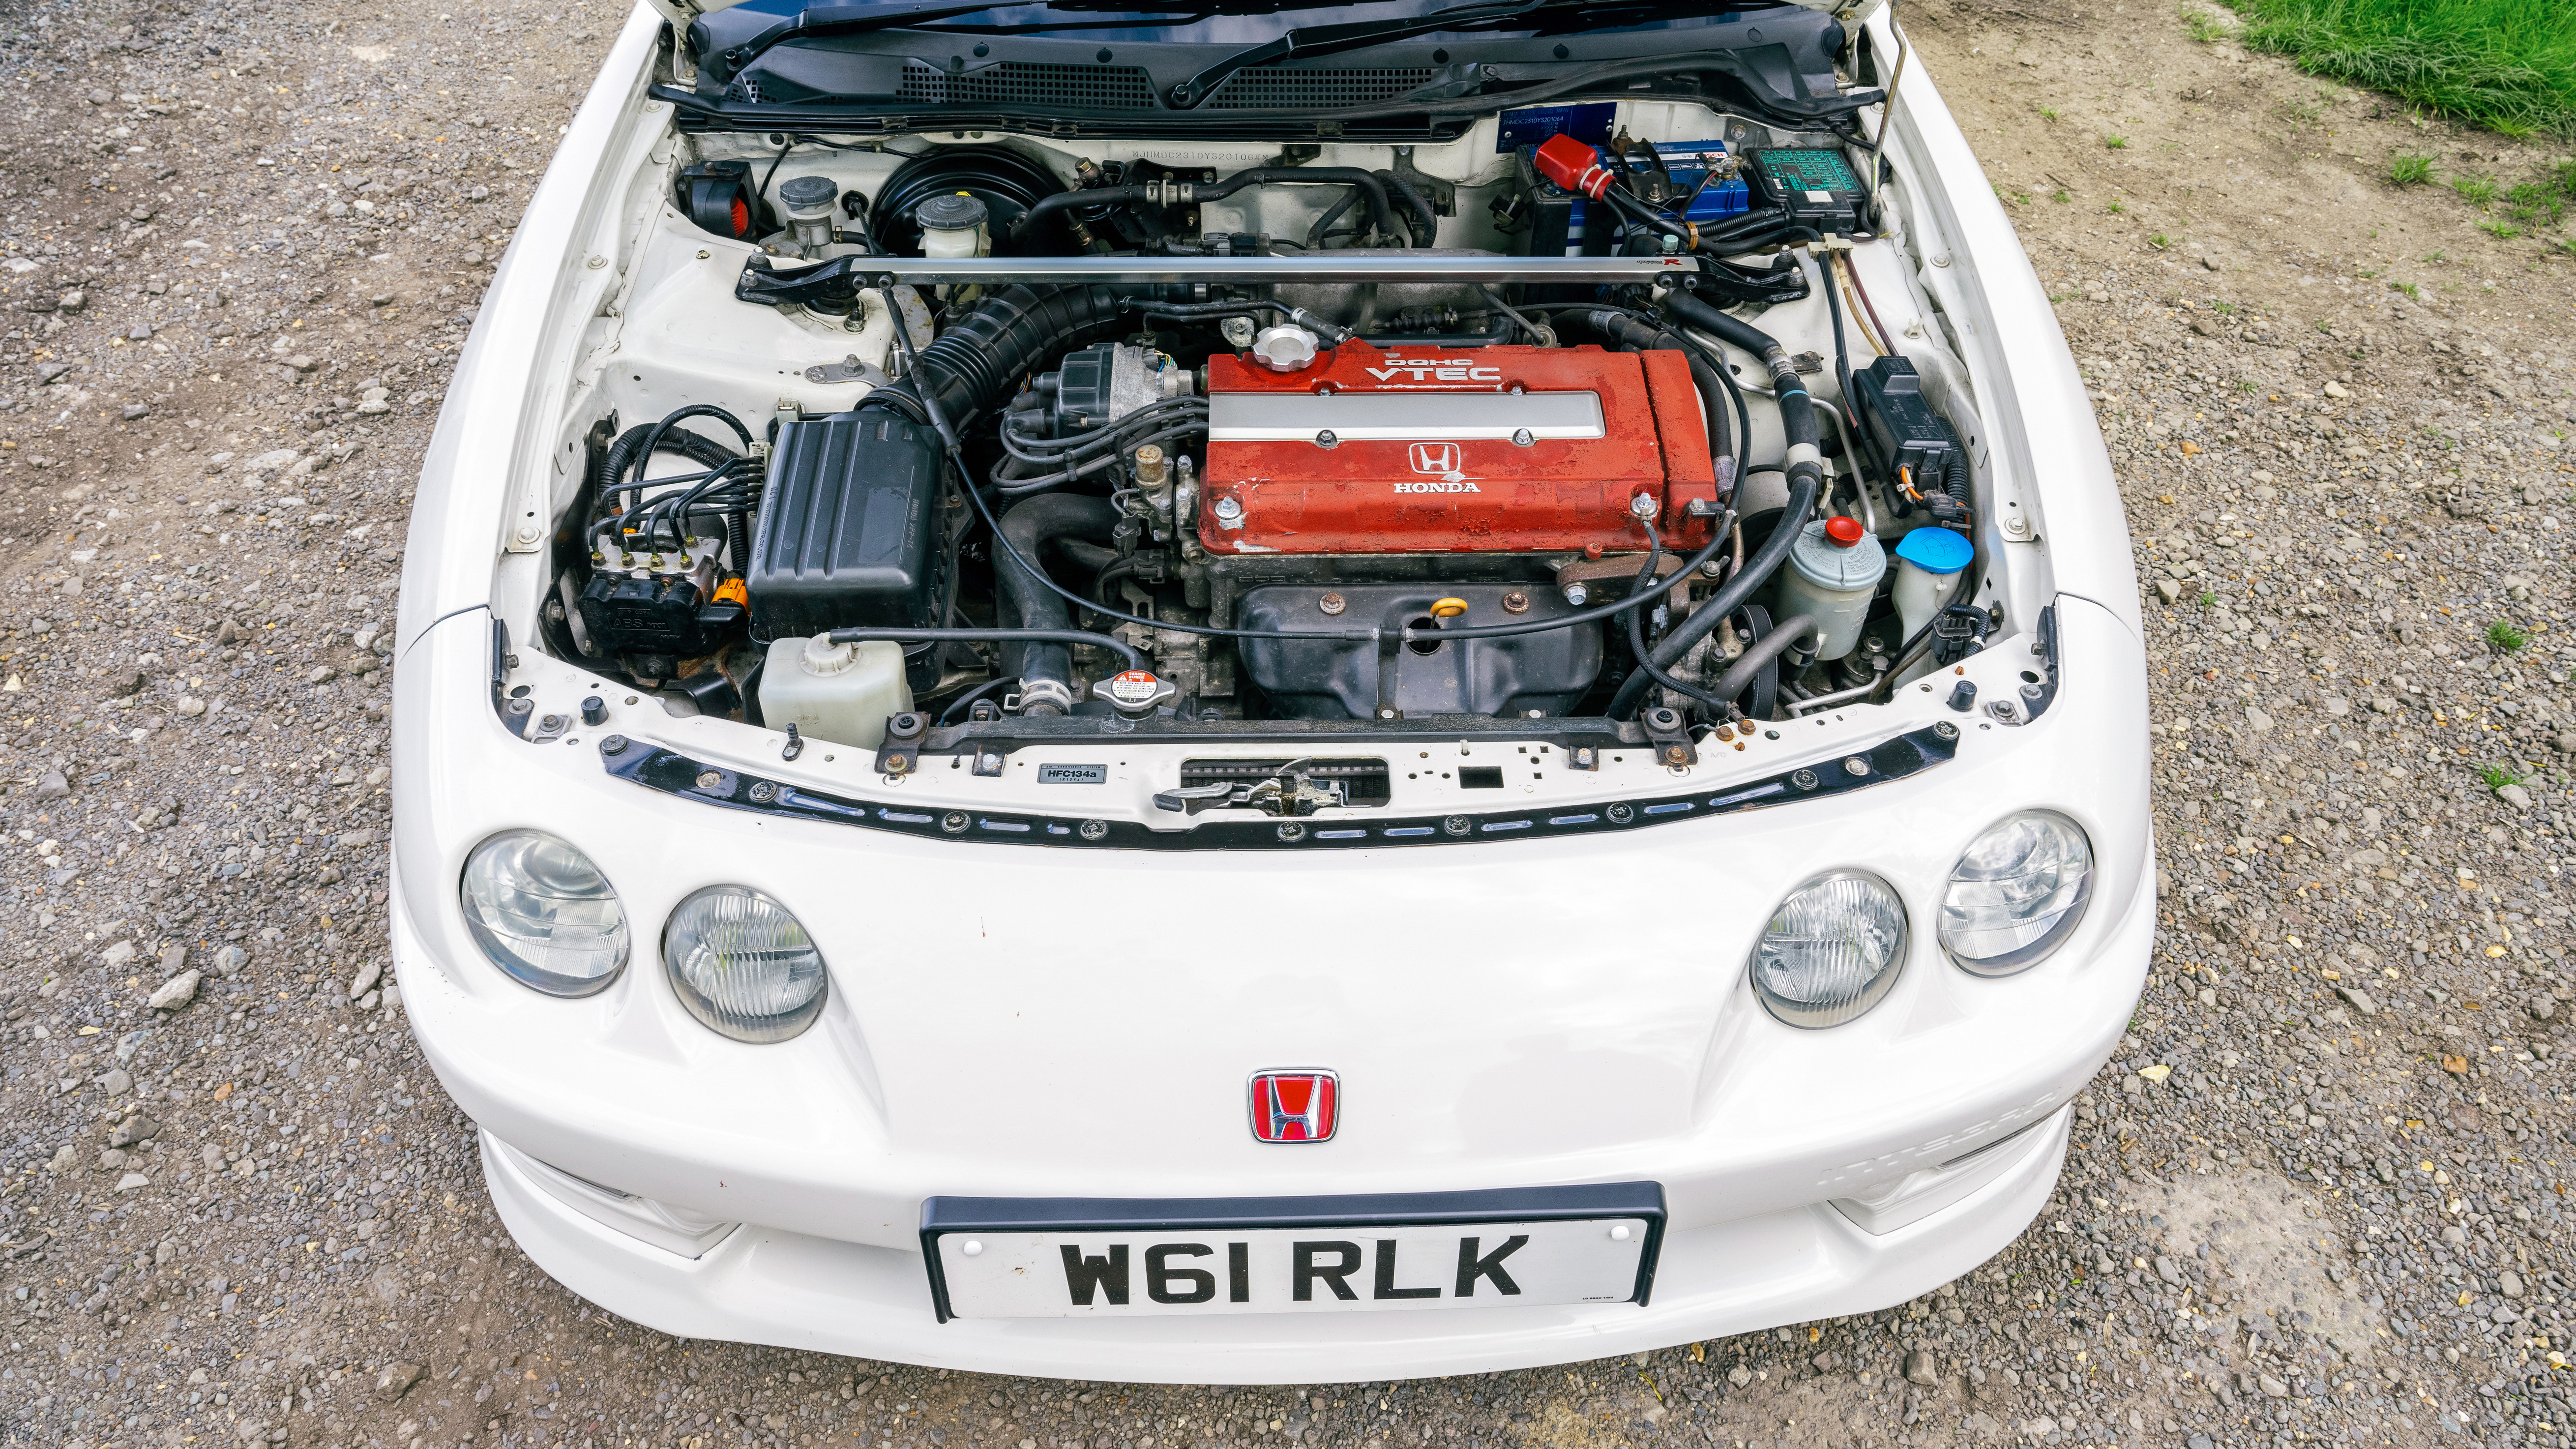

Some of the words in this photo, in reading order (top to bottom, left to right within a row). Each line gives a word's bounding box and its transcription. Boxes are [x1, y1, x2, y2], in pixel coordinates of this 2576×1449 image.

[1503, 116, 1563, 125] JHMDC2310YS201064
[1365, 367, 1501, 382] VTEC
[1393, 482, 1481, 493] HONDA
[911, 499, 919, 520] HONDA
[614, 619, 643, 628] ABS
[1817, 1086, 2062, 1185] INTEGRA
[1059, 1241, 1250, 1306] W61
[1292, 1234, 1530, 1301] RLK
